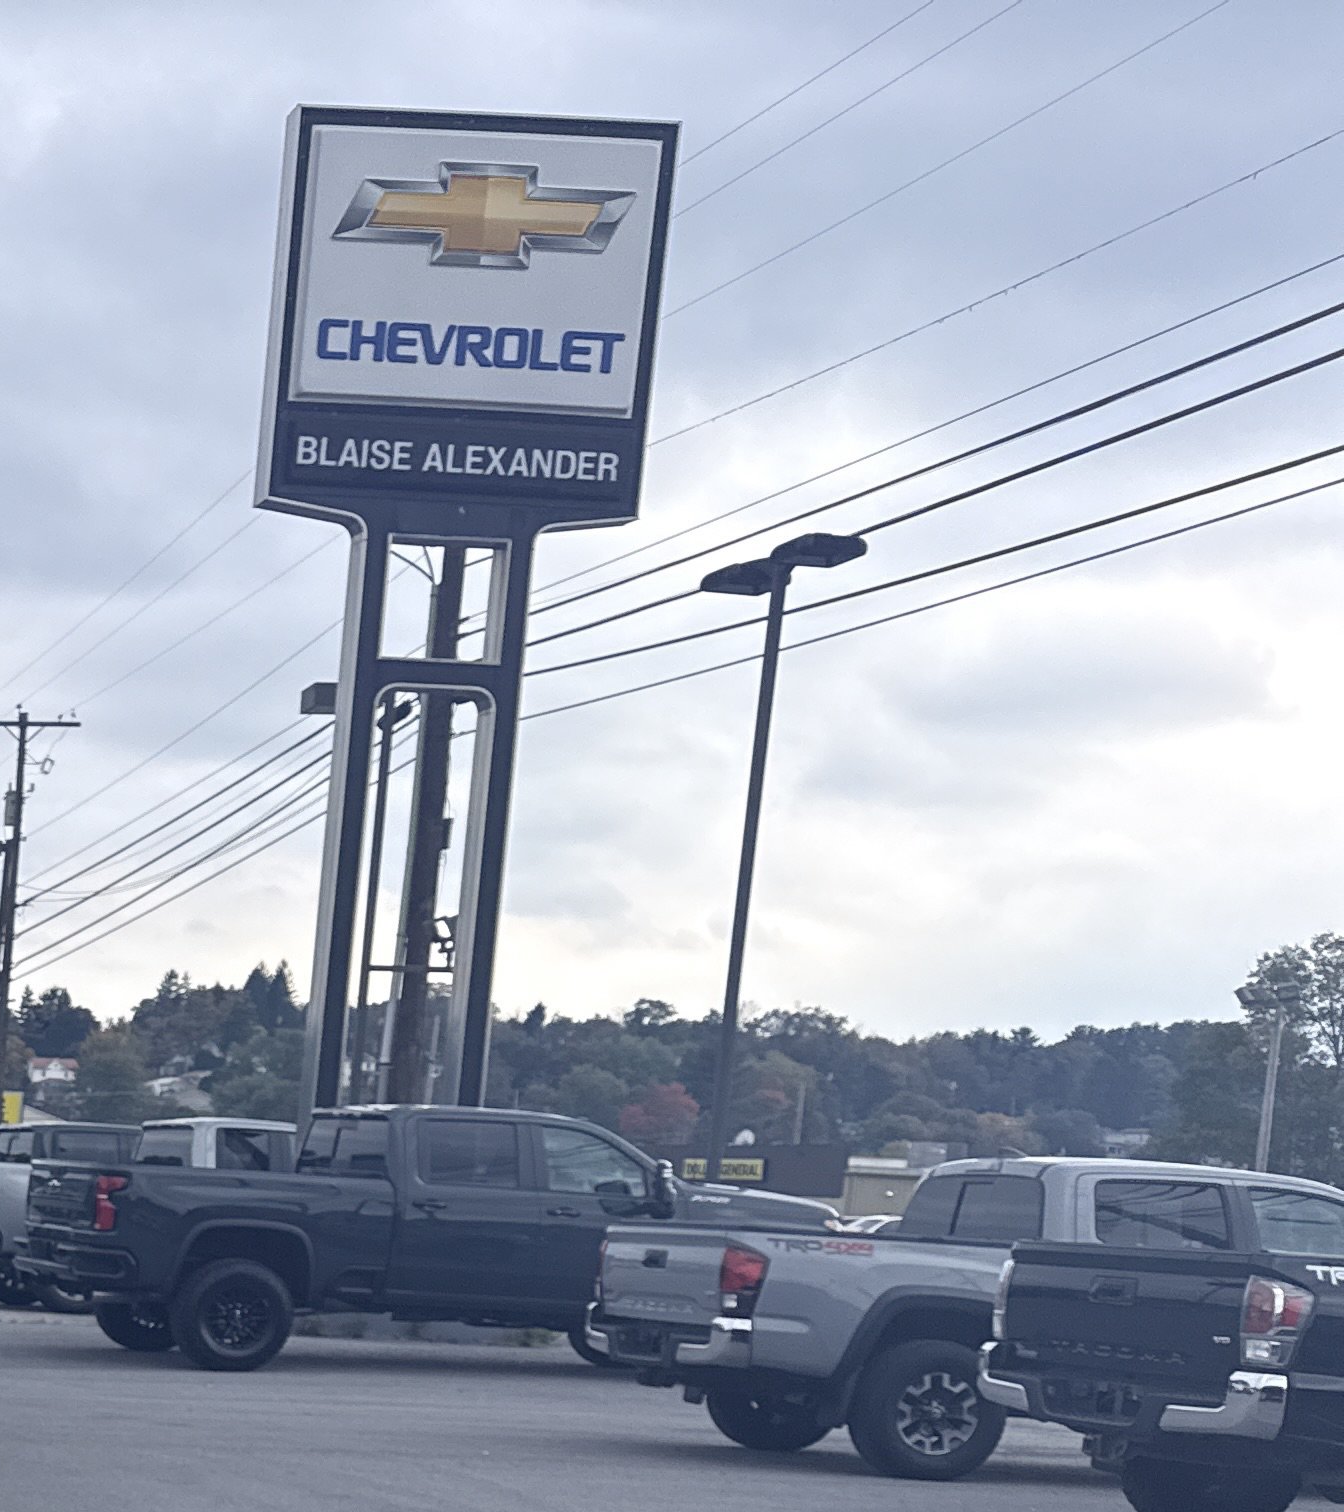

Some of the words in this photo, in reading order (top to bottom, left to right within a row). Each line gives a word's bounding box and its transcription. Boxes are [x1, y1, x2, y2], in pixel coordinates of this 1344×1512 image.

[316, 318, 626, 375] CHEVROLET
[295, 435, 414, 471] BLAISE
[422, 443, 620, 482] ALEXANDER
